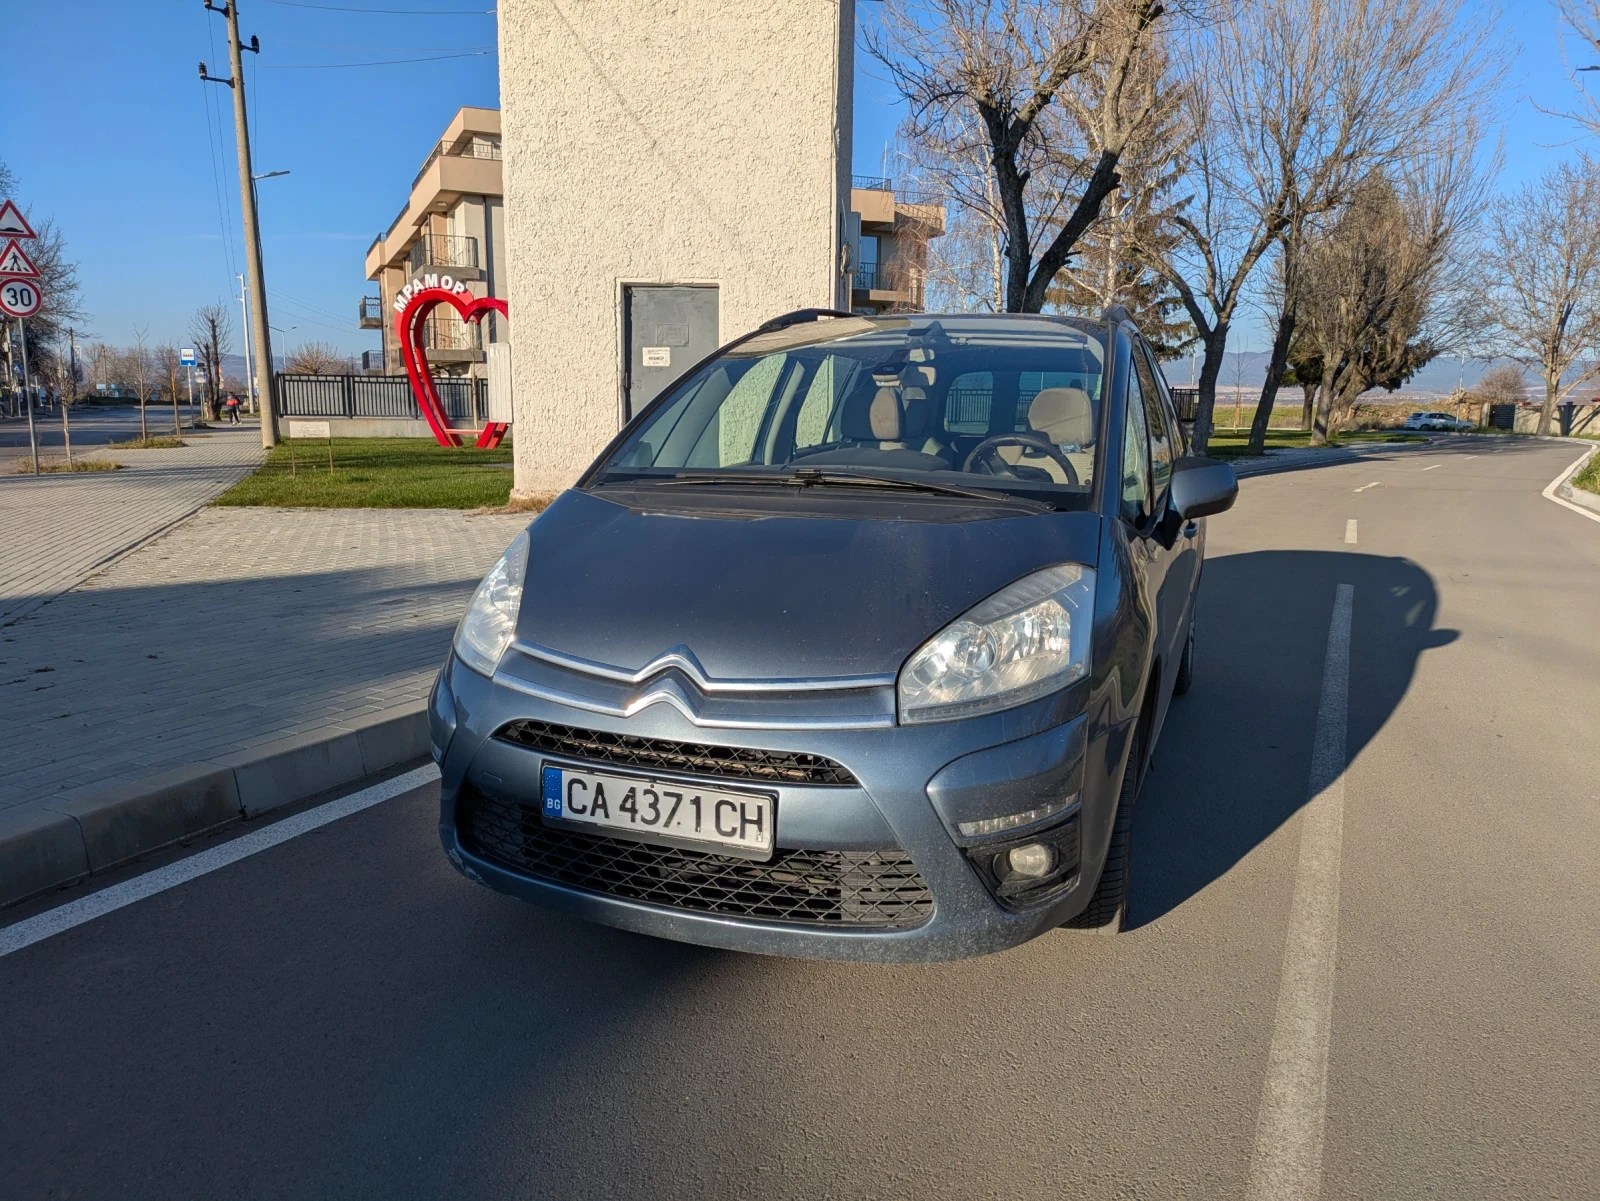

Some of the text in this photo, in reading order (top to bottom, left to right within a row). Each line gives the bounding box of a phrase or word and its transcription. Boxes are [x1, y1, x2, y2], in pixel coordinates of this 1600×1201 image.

[6, 287, 32, 307] 30
[393, 273, 466, 314] МРАМОР
[546, 798, 561, 810] BG
[567, 778, 763, 842] CA 4371 CH
